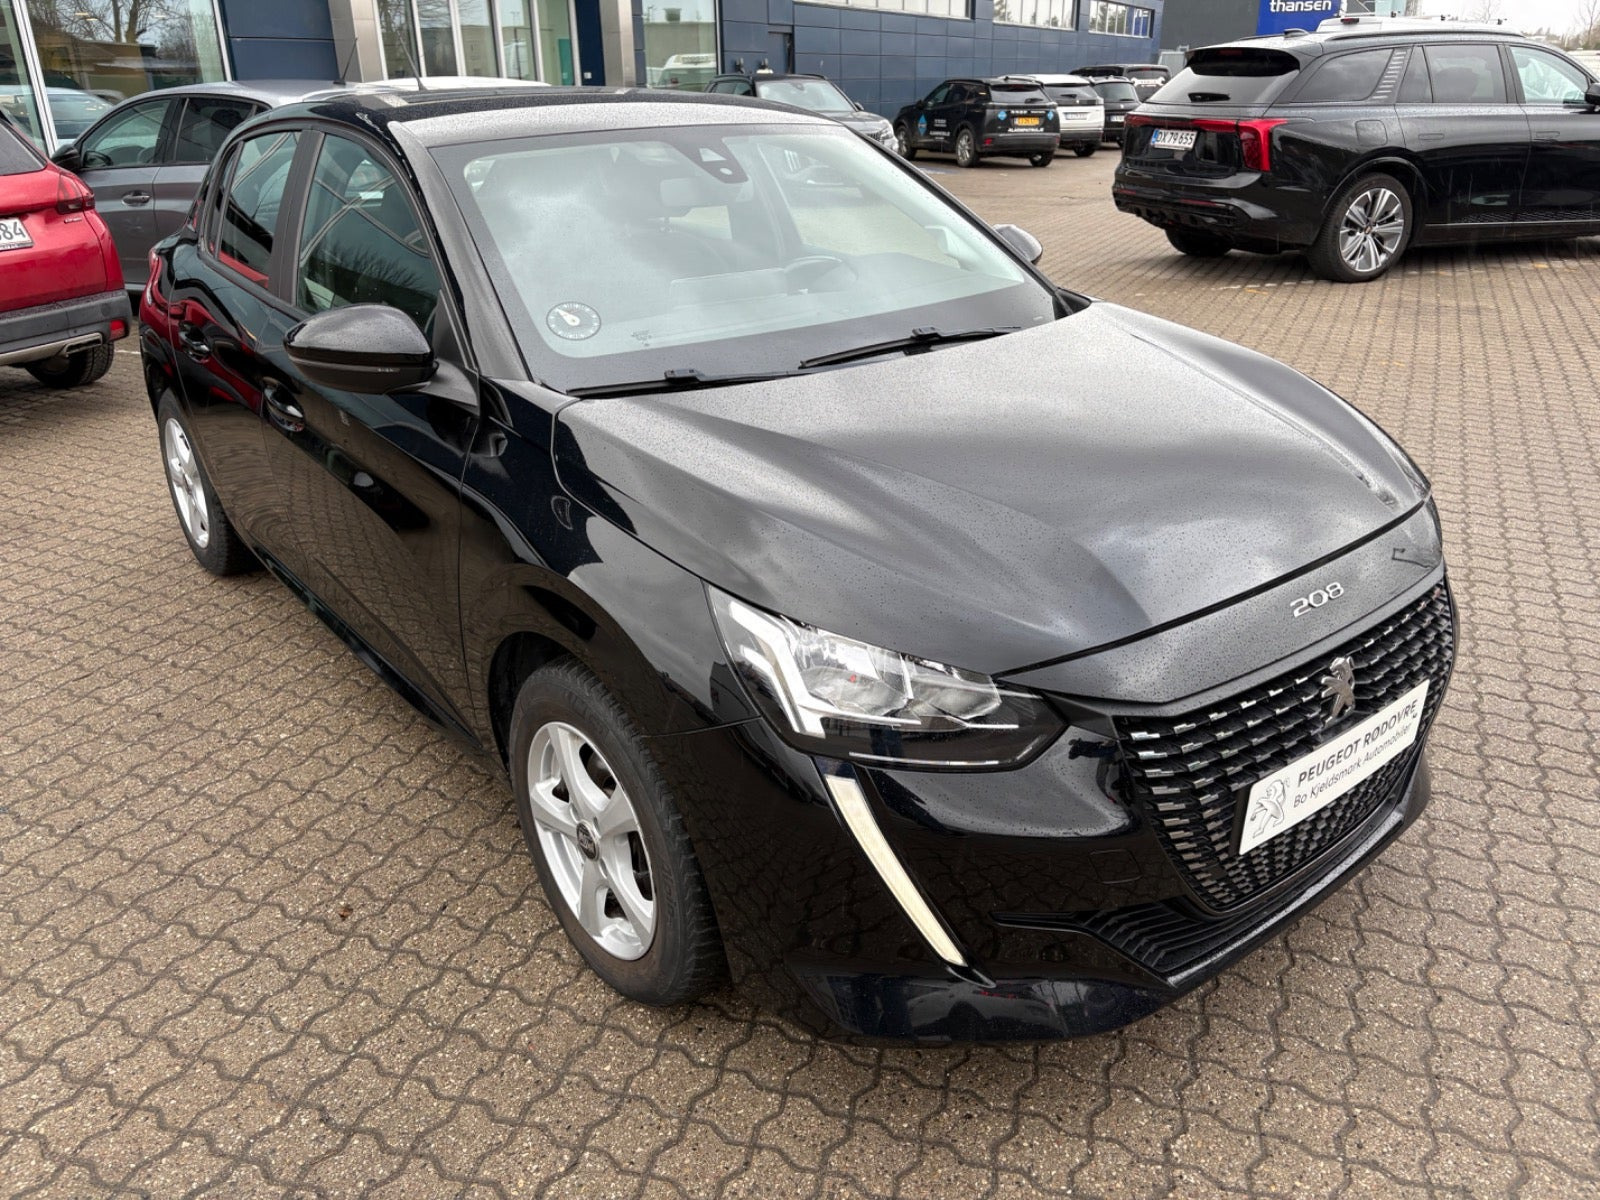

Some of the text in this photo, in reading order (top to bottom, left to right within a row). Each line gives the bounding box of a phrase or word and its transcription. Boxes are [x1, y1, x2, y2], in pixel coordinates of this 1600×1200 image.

[1269, 0, 1332, 13] thansen
[1156, 131, 1194, 145] DX 79 655
[0, 221, 26, 241] 84
[1290, 581, 1344, 618] 208
[1297, 699, 1418, 788] PEUGEOT RØDOVRE
[1294, 722, 1412, 808] Bo Kjeldsmark Automobiler
